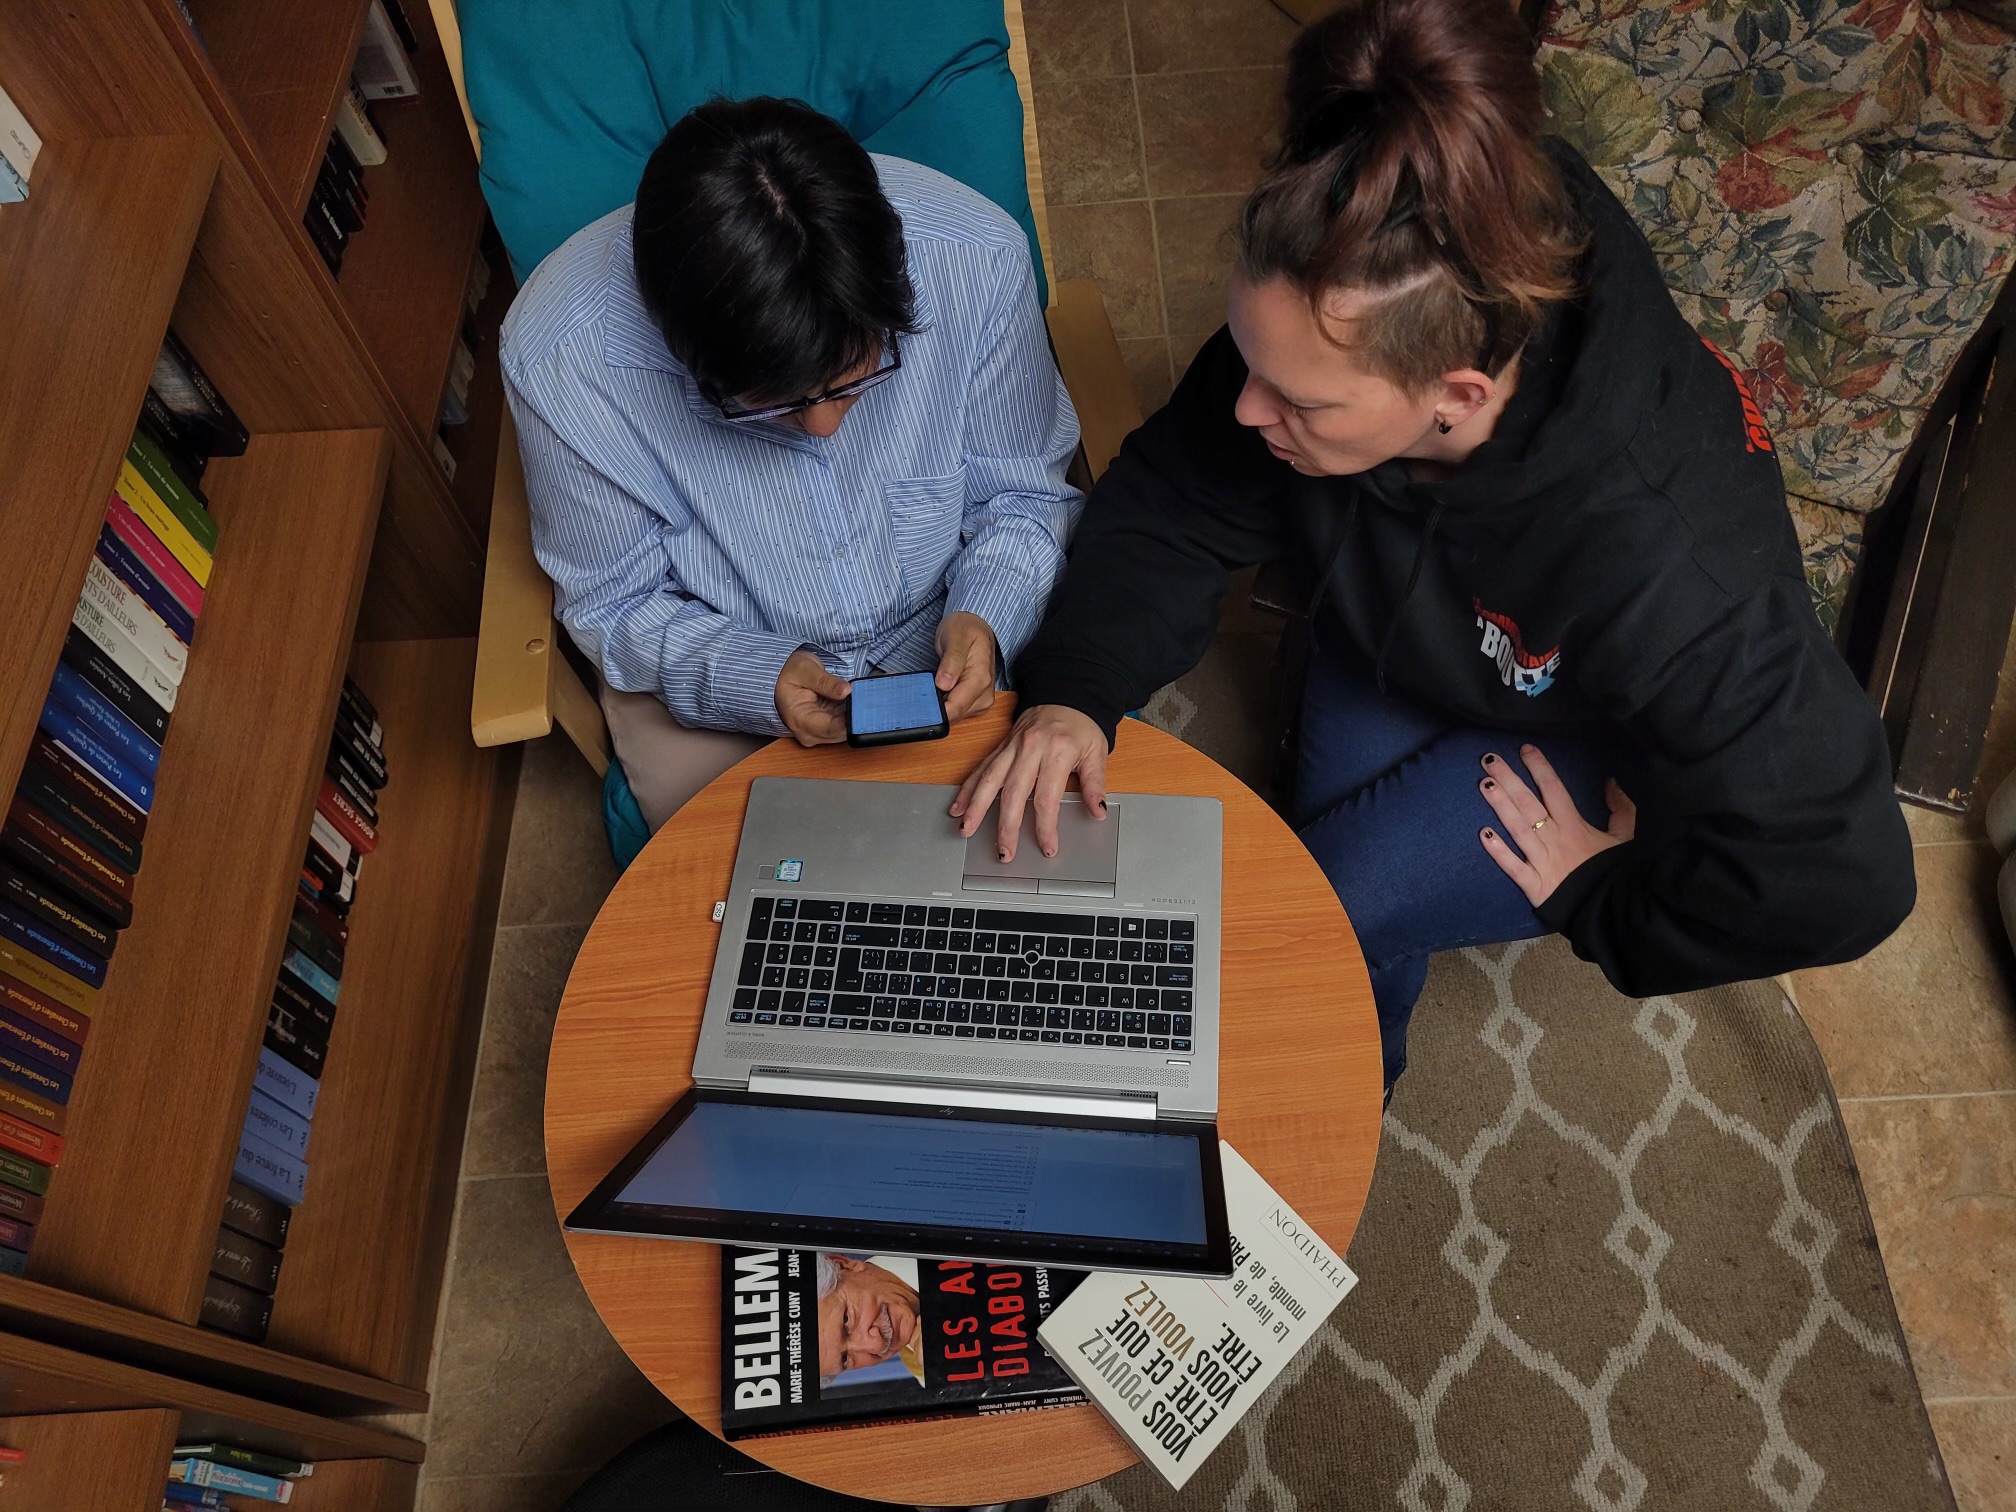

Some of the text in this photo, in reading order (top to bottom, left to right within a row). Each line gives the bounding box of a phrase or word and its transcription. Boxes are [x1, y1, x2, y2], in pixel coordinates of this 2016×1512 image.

[321, 202, 332, 219] Tom
[65, 730, 87, 749] Québec
[94, 753, 112, 769] Portes
[331, 793, 356, 818] SECRET
[70, 916, 96, 936] Chevaliers
[95, 932, 107, 943] Les
[59, 948, 86, 967] Chevaliers
[86, 963, 96, 973] Les
[31, 1036, 59, 1055] Chevaliers
[60, 1050, 70, 1060] Les
[21, 1068, 49, 1085] Chevaliers
[48, 1080, 59, 1090] Les
[15, 1097, 44, 1114] Chevaliers
[44, 1109, 55, 1119] Les
[241, 1148, 255, 1164] du
[274, 1160, 291, 1185] La
[1268, 1208, 1348, 1290] PHAIDON
[1249, 1260, 1267, 1281] de
[787, 1290, 801, 1320] CUNY
[1268, 1275, 1307, 1322] monde,
[985, 1262, 1030, 1377] DIABO
[1232, 1279, 1291, 1344] Le livre le
[942, 1316, 985, 1382] LES
[1123, 1279, 1240, 1411] VOUS VOULEZ
[786, 1320, 803, 1404] MARIE-THÉRÈSE
[1105, 1308, 1220, 1438] ÊTRE CE QUE
[1077, 1327, 1196, 1463] VOUS POUVEZ
